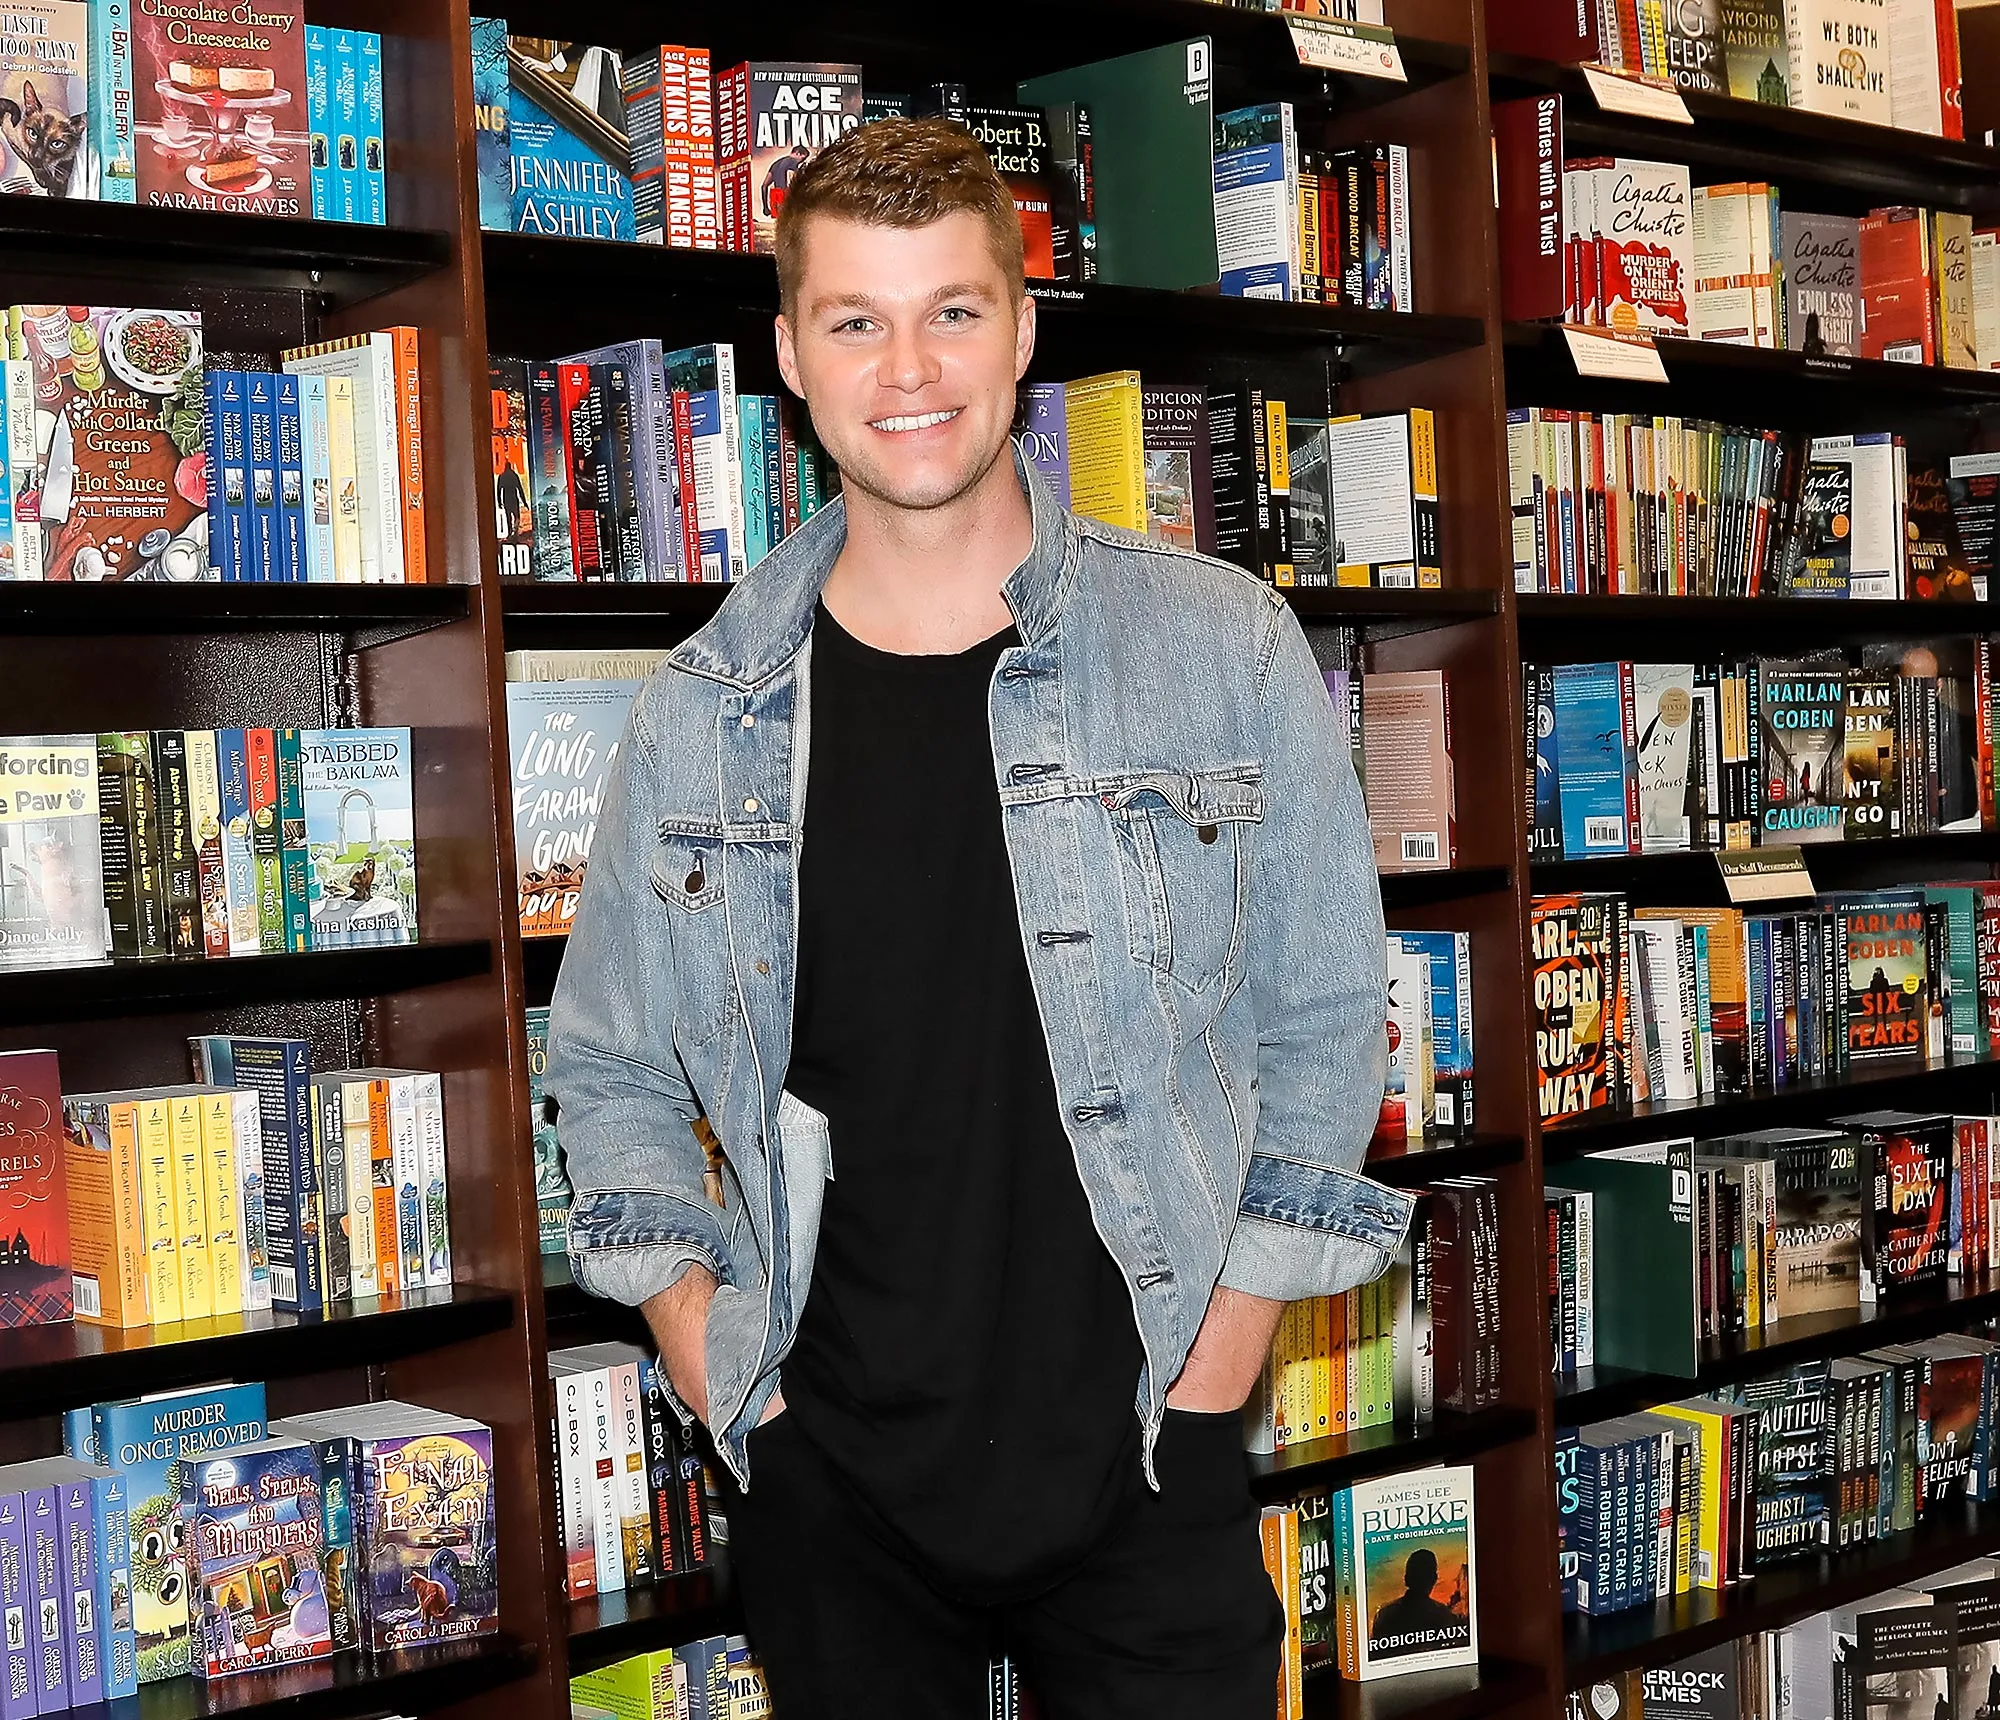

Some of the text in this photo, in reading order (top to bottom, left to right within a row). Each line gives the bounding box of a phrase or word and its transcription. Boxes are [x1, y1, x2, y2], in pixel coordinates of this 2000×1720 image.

[140, 0, 295, 34] Chocolate Cherry
[111, 31, 128, 60] BAT
[167, 20, 271, 51] Cheesecake
[1822, 21, 1878, 49] WE BOTH
[35, 40, 79, 62] MANY
[664, 51, 686, 62] ACE
[2, 62, 27, 71] Debra
[38, 64, 77, 75] Goldstein
[114, 70, 123, 87] THE
[1817, 63, 1855, 88] SHALL
[664, 62, 688, 139] ATKINS
[772, 85, 842, 112] ACE
[114, 90, 130, 142] BELFRY
[510, 155, 625, 200] JENNIFER
[1348, 167, 1358, 212] LINWOOD
[1538, 99, 1557, 256] Stories with a Twist
[1612, 173, 1684, 208] Agatha
[149, 191, 300, 215] SARAH GRAVES
[669, 172, 692, 249] RANGER
[518, 198, 621, 239] ASHLEY
[1304, 192, 1317, 273] Linwood Barclay
[1612, 206, 1685, 236] Christie
[1349, 212, 1359, 258] BARCLAY
[1794, 231, 1855, 264] Agatha
[1620, 253, 1671, 269] MURDER
[1624, 267, 1669, 279] ON THE
[1794, 261, 1855, 288] Christie
[1630, 276, 1675, 290] ORIENT
[1631, 288, 1680, 303] EXPRESS
[1797, 289, 1853, 319] ENDLESS
[1819, 317, 1853, 344] NIGHT
[87, 390, 148, 410] Murder
[71, 412, 165, 432] with Collard
[232, 413, 243, 460] MAY DAY
[406, 368, 421, 484] The Bengal Identity
[579, 399, 592, 457] NEVADA
[87, 432, 150, 452] Greens
[223, 412, 233, 462] MURDER
[107, 457, 131, 469] and
[1252, 390, 1269, 530] THE SECOND RIDER ALEX BEER
[73, 473, 166, 493] Hot Sauce
[78, 506, 166, 518] A.L. HERBERT
[547, 501, 562, 567] BOAR ISLAND
[621, 527, 632, 562] ANGEL
[1300, 574, 1328, 587] BENN
[1527, 680, 1535, 713] SILENT
[1766, 683, 1841, 703] HARLAN
[544, 711, 577, 732] THE
[1625, 701, 1635, 747] LIGHTNING
[1772, 709, 1834, 729] COBEN
[1526, 716, 1534, 759] VOICES
[300, 743, 399, 764] STABBED
[515, 730, 596, 781] LONG
[326, 765, 400, 781] BAKLAVA
[16, 790, 62, 812] Paw
[254, 780, 264, 803] PAW
[169, 768, 184, 849] Above the Paw
[1765, 805, 1841, 831] CAUGHT
[1854, 805, 1884, 823] GO
[1724, 859, 1802, 874] Our Staff Recommends
[1849, 939, 1914, 960] COBEN
[1617, 901, 1632, 1085] HARLAN COBEN RUN AWAY
[1862, 991, 1901, 1017] SIX
[1460, 989, 1470, 1037] HEAVEN
[1849, 1019, 1919, 1048] YEARS
[1681, 1029, 1694, 1076] HOME
[1911, 1144, 1930, 1155] THE
[1893, 1157, 1945, 1185] SIXTH
[1903, 1186, 1936, 1211] DAY
[1776, 1220, 1859, 1247] PARADOX
[1889, 1229, 1946, 1252] CATHERINE
[1767, 1250, 1776, 1301] NEMESIS
[1888, 1249, 1945, 1275] COULTER
[1564, 1301, 1575, 1353] ENIGMA
[153, 1403, 226, 1435] MURDER
[120, 1421, 262, 1465] ONCE REMOVED
[652, 1424, 665, 1461] BOX
[372, 1451, 488, 1492] FINAL
[204, 1475, 317, 1508] BELLS, SPELLS,
[1377, 1486, 1451, 1505] JAMES LEE
[1936, 1481, 1949, 1499] IT
[248, 1504, 274, 1525] AND
[378, 1493, 485, 1532] EXAM
[602, 1481, 614, 1573] WINTERKILL
[632, 1478, 645, 1565] OPEN SEASON
[687, 1481, 703, 1562] PARADISE VALLEY
[1362, 1500, 1468, 1532] BURKE
[1599, 1490, 1611, 1548] ROBERT
[207, 1518, 319, 1558] MURDERS
[657, 1489, 673, 1572] PARADISE VALLEY
[1371, 1534, 1391, 1543] DAVE
[1394, 1528, 1445, 1540] ROBICHEAUX
[1616, 1486, 1628, 1592] ROBERT CRAIS
[1632, 1483, 1645, 1587] ROBERT CRAIS
[1598, 1550, 1610, 1596] CRAIS
[385, 1618, 481, 1644] CAROL J. PERRY
[1369, 1626, 1468, 1651] ROBICHEAUX
[1891, 1621, 1932, 1632] COMPLETE
[1915, 1629, 1948, 1638] HOLMES
[219, 1645, 314, 1672] CAROL J. PERRY
[728, 1674, 766, 1699] MRS.
